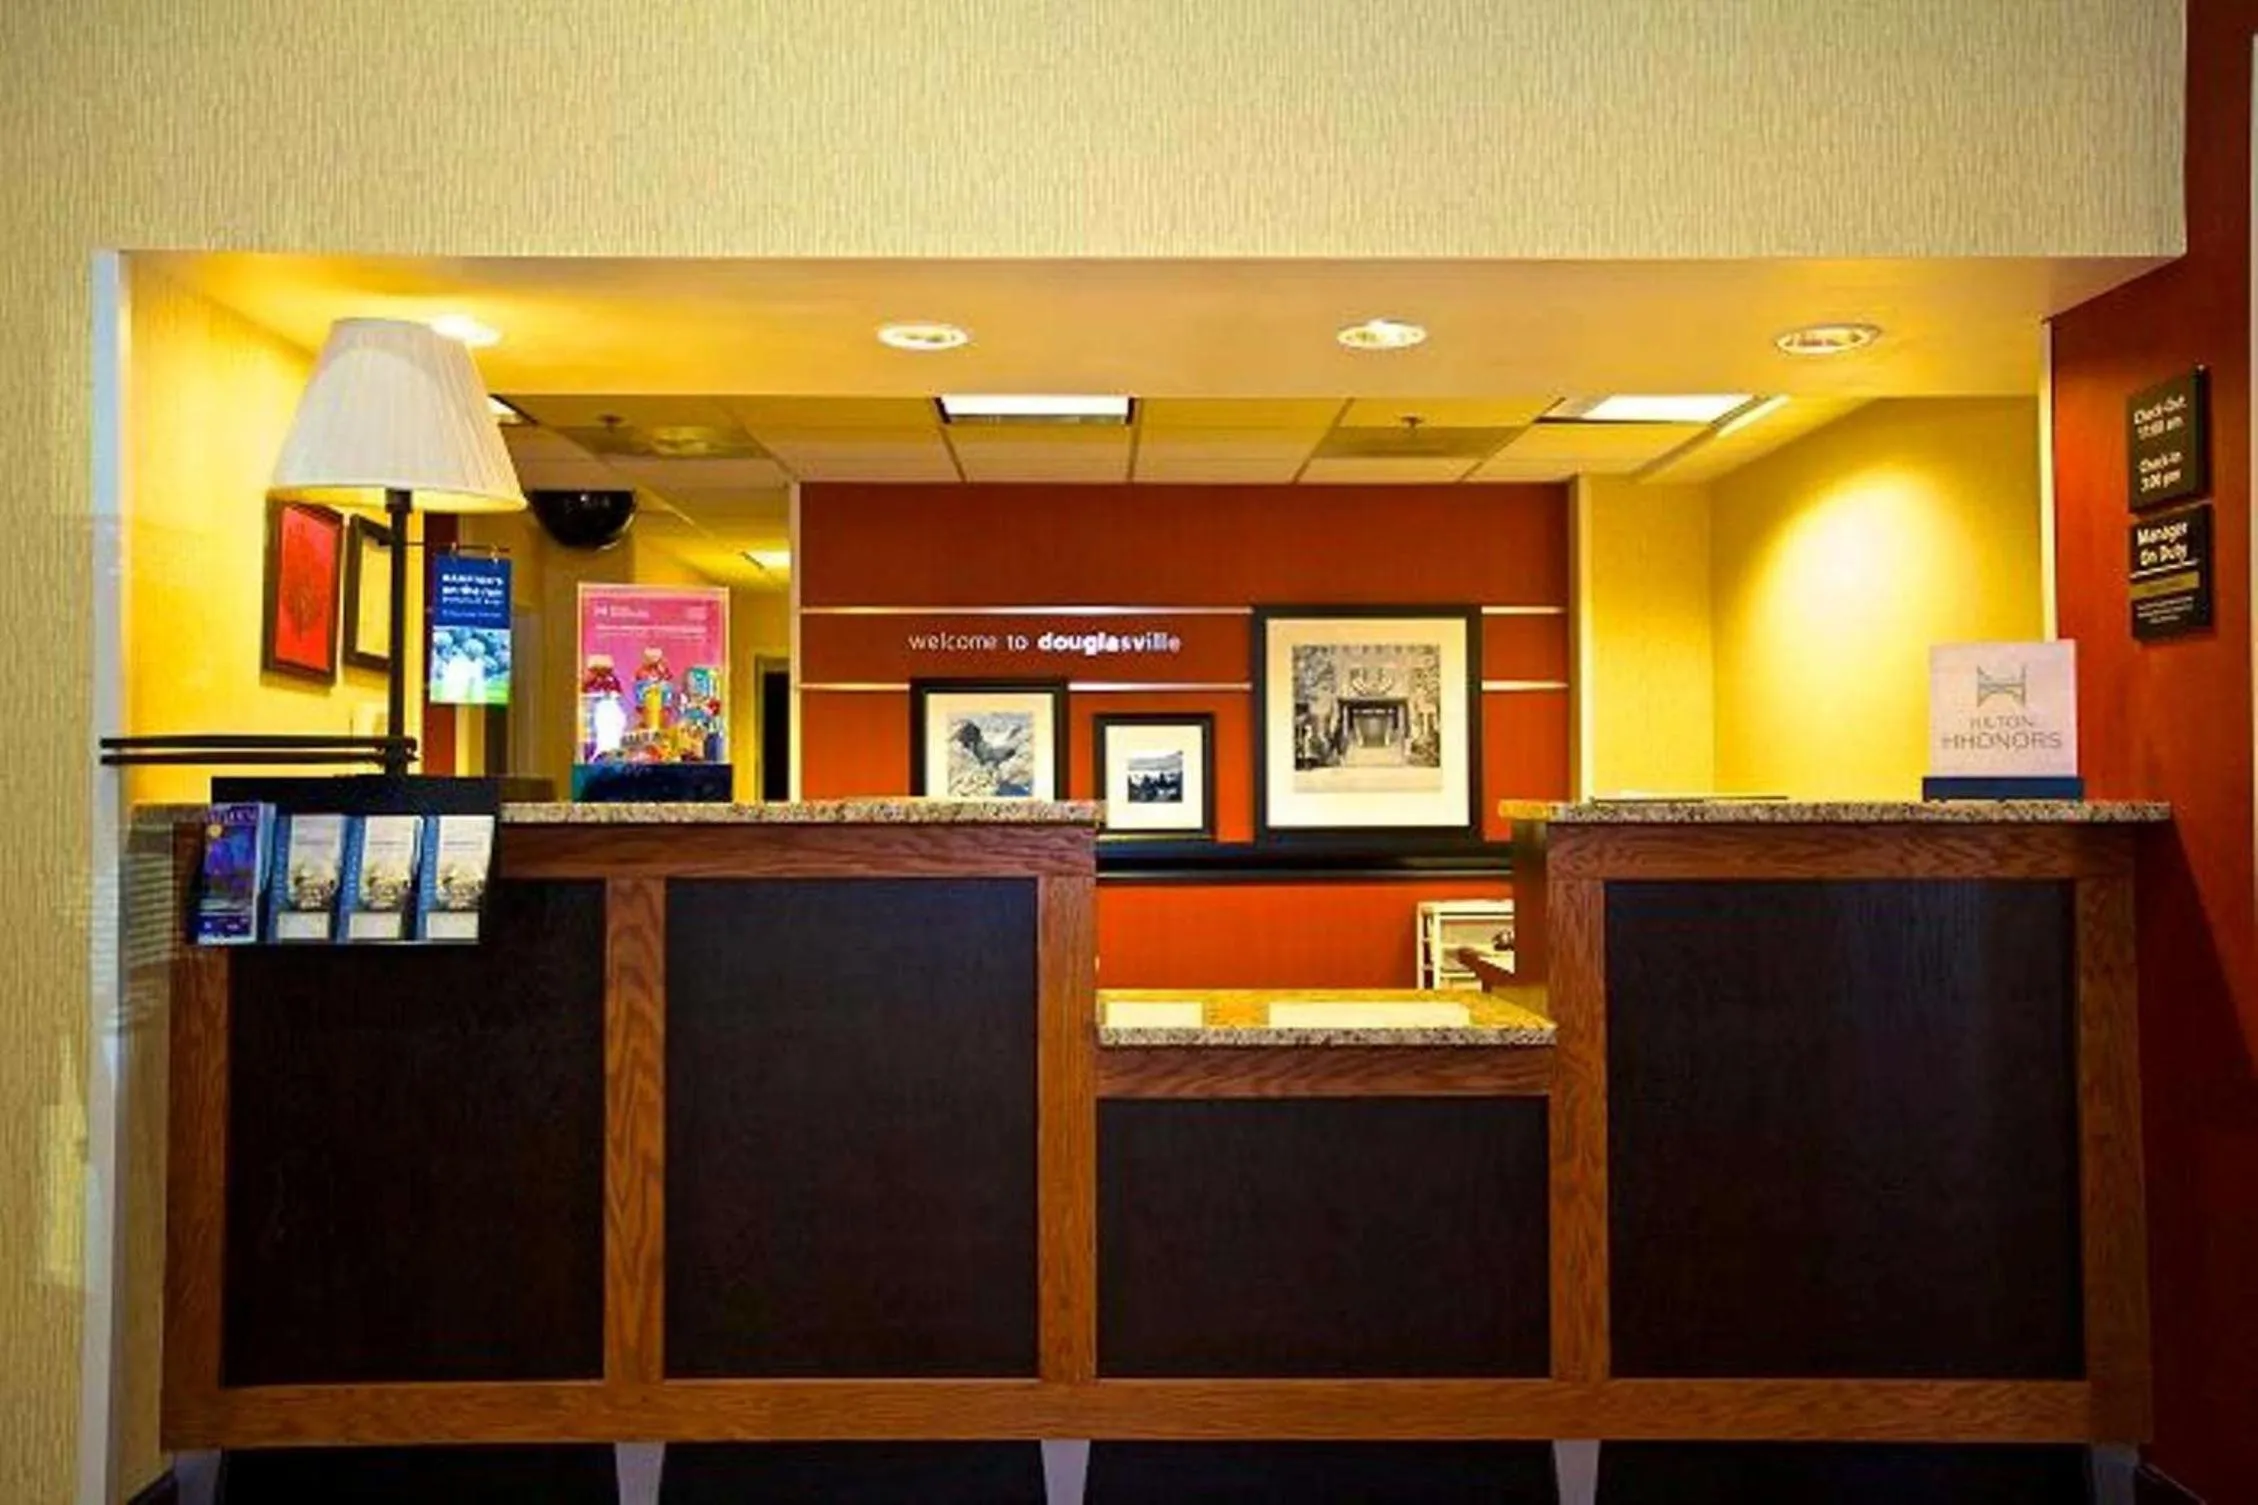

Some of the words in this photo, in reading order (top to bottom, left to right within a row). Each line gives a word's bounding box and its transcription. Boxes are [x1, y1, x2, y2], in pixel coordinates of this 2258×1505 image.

[2137, 522, 2188, 547] Manager
[2140, 549, 2158, 566] On
[2160, 544, 2188, 566] Duty
[908, 632, 998, 651] welcome
[1007, 634, 1029, 651] to
[1037, 631, 1182, 656] douglasville
[1970, 715, 2034, 729] HILTON
[1942, 731, 2063, 751] HHONORS
